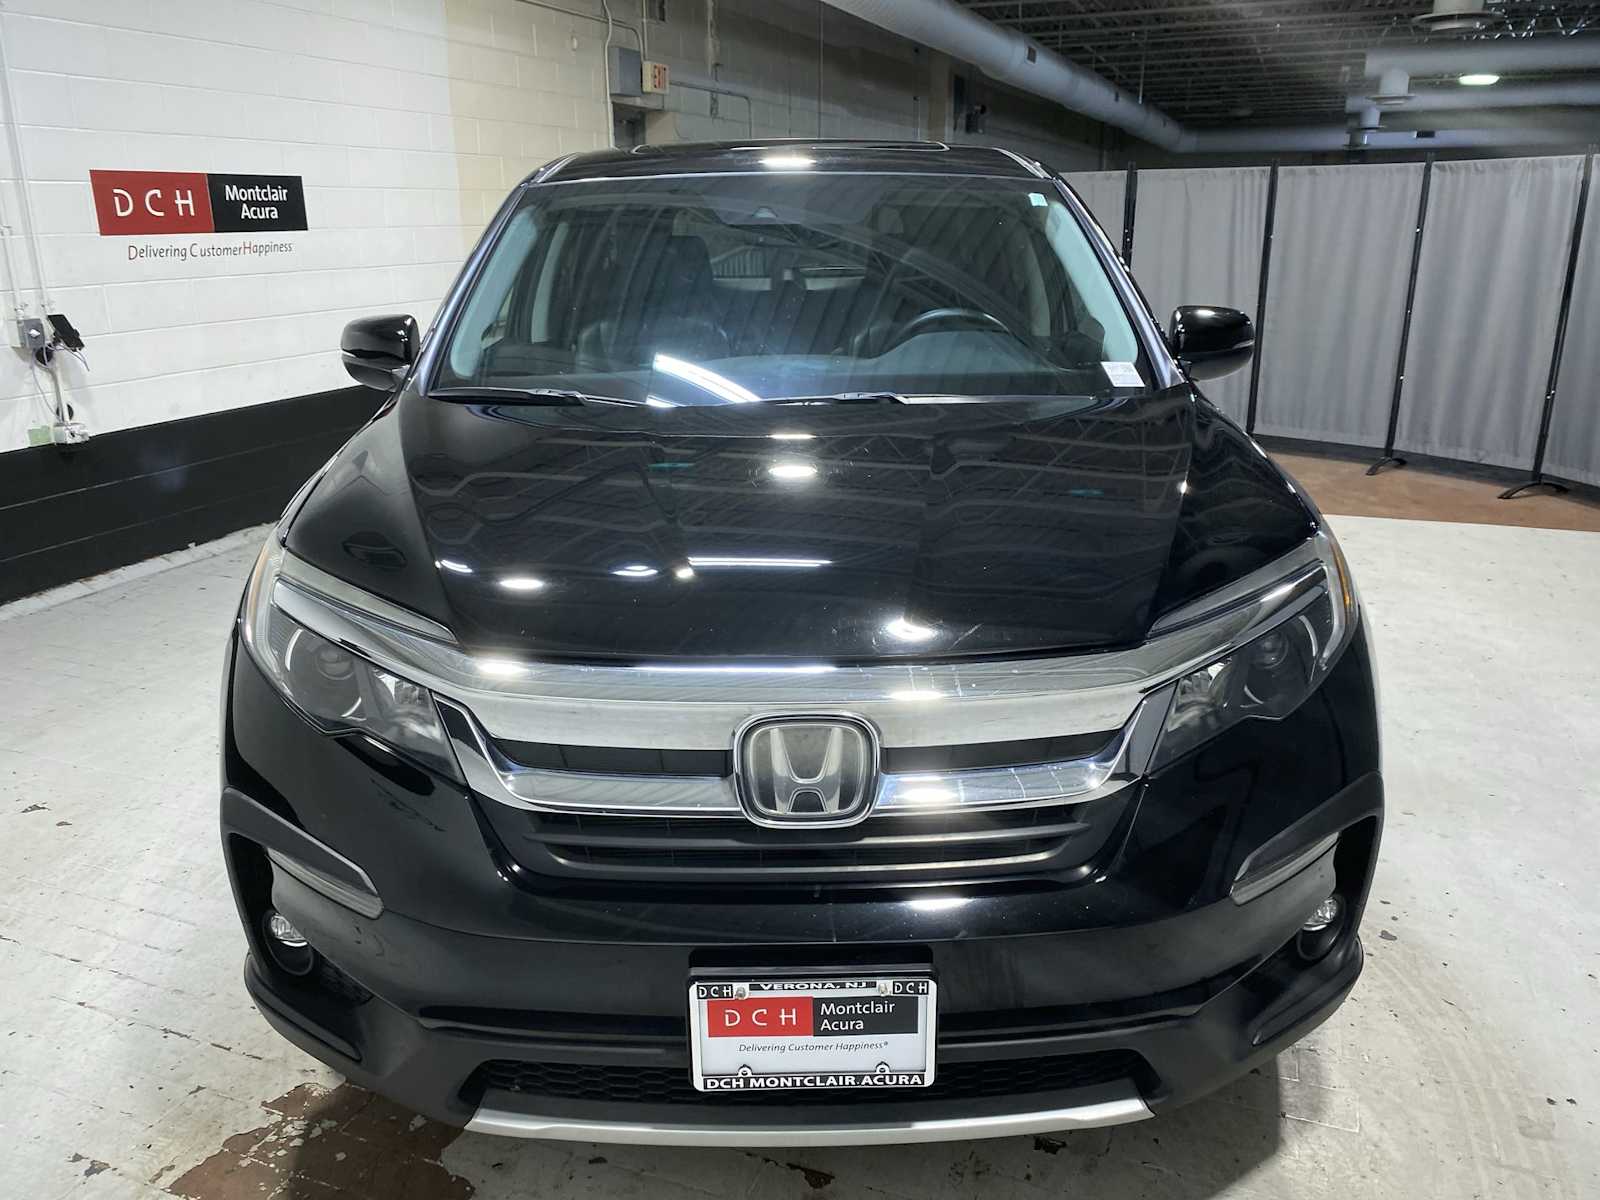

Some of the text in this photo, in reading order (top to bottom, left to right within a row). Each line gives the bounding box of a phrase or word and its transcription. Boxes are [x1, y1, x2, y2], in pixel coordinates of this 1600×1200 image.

[225, 184, 288, 202] Montclair
[241, 203, 279, 219] Acura
[128, 245, 187, 261] Delivering
[698, 986, 732, 998] DCH
[894, 982, 928, 993] DCH
[820, 1001, 895, 1015] Montclair
[724, 1008, 796, 1027] DCH
[820, 1019, 864, 1031] Acura
[739, 1044, 785, 1053] Delivering
[788, 1043, 833, 1052] Customer
[706, 1078, 744, 1089] DCH
[861, 1074, 922, 1085] ACURA
